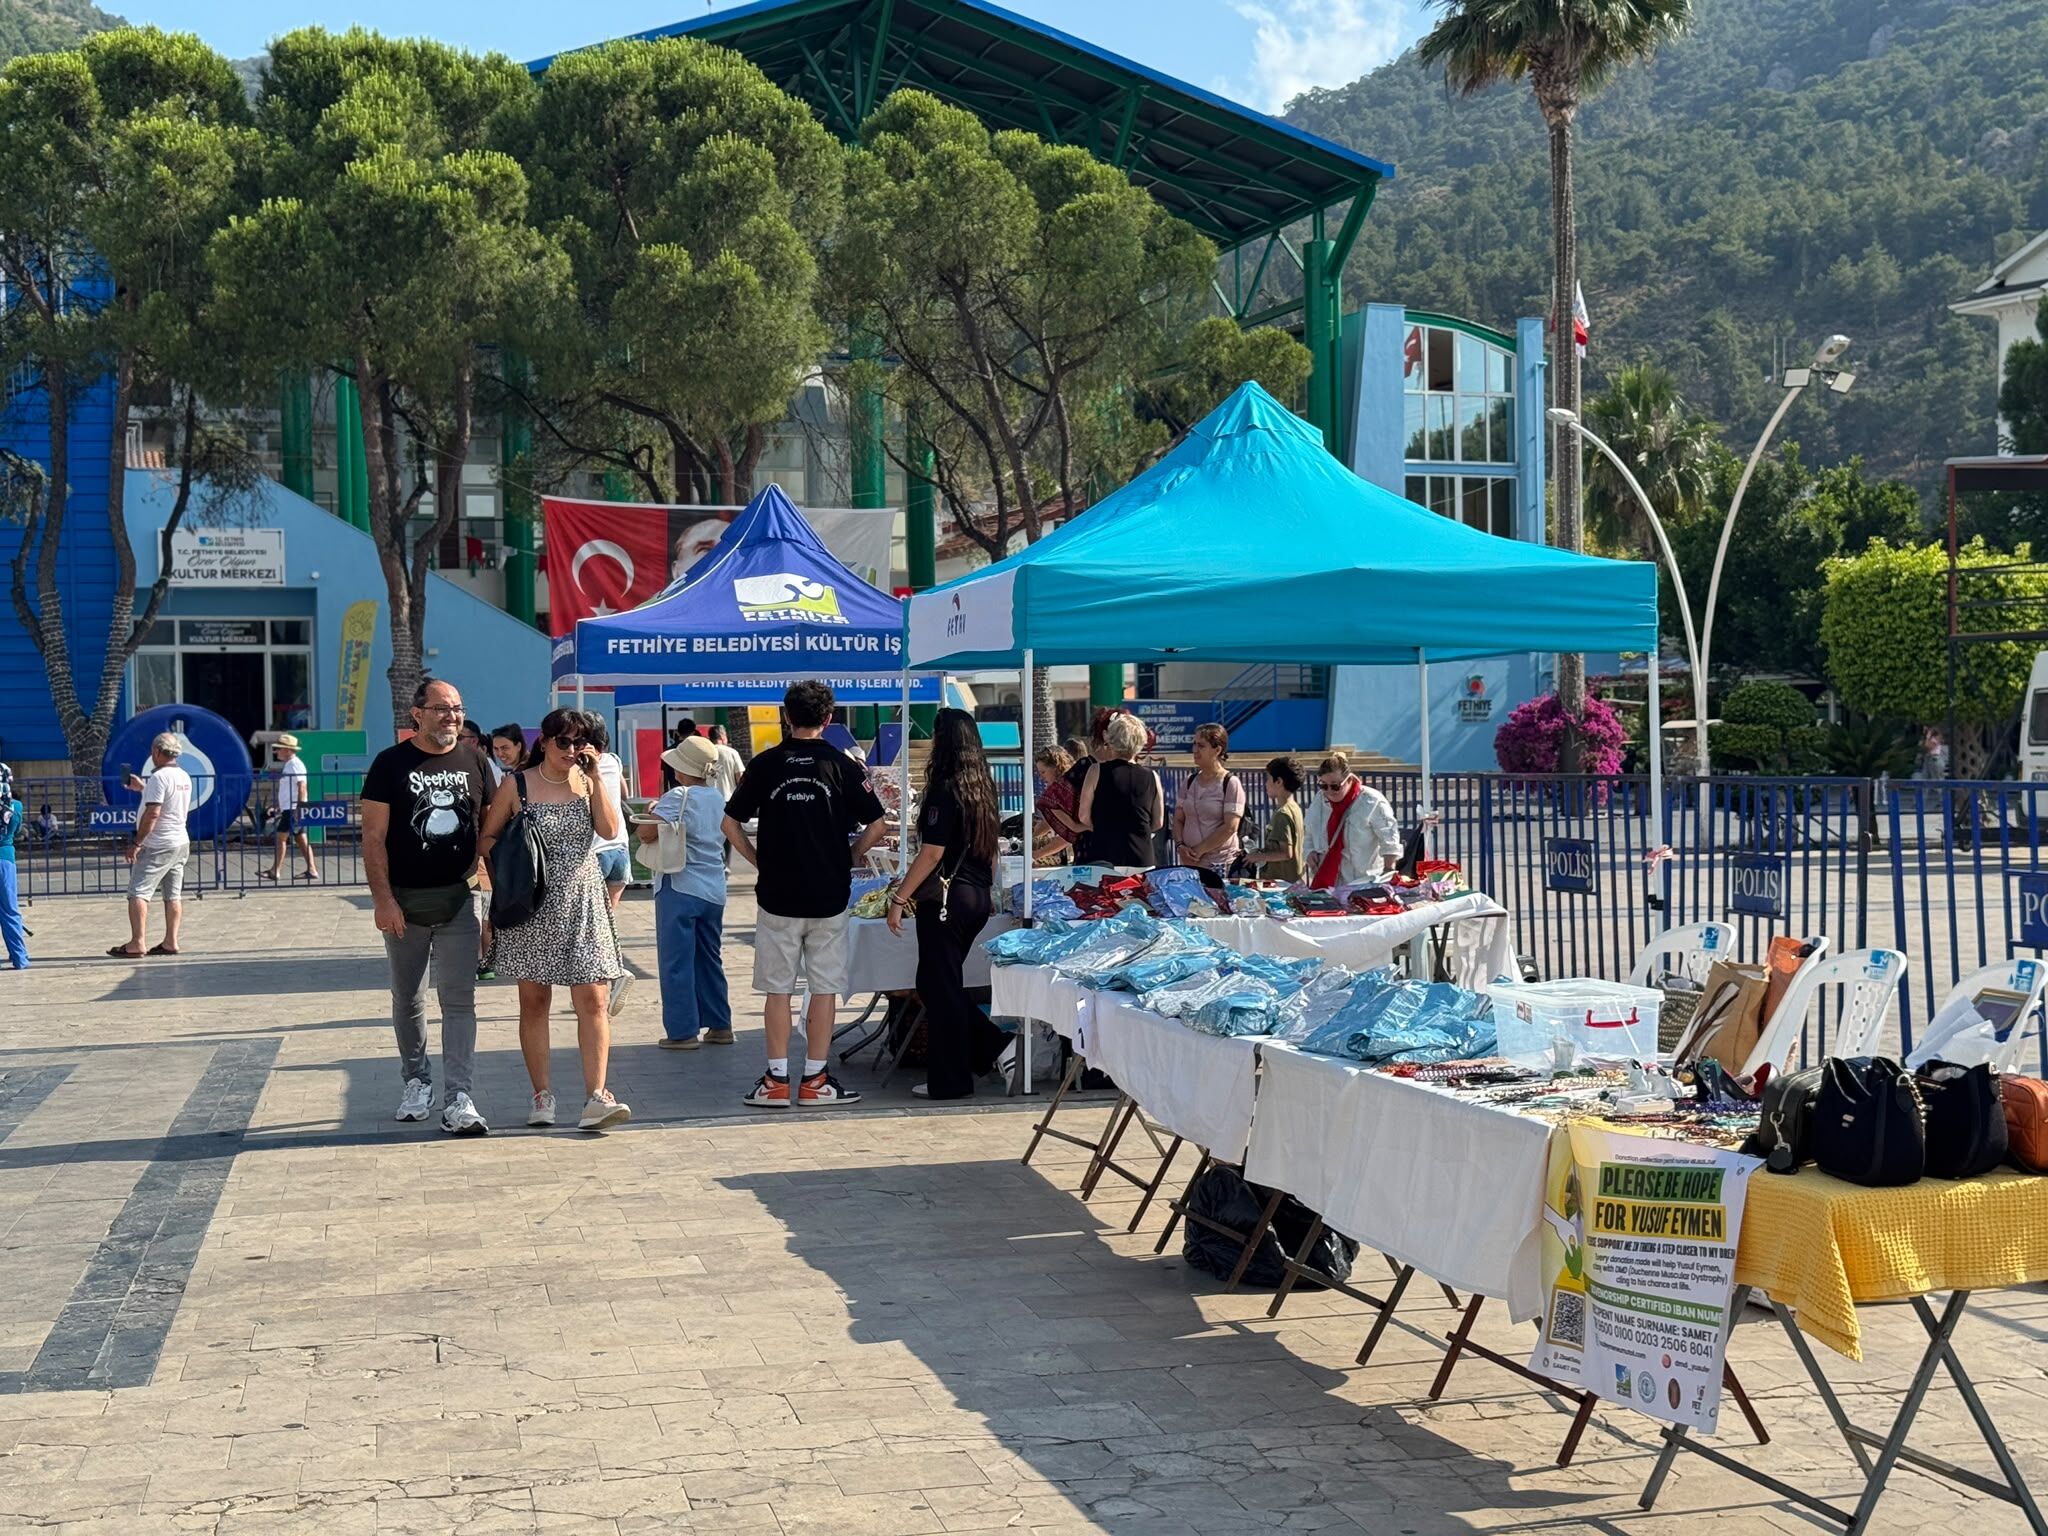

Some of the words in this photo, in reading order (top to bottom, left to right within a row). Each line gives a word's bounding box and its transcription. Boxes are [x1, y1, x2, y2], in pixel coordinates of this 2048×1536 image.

[607, 635, 687, 654] FETHİYE
[692, 632, 800, 653] BELEDİYESİ
[805, 632, 879, 652] KÜLTÜR
[884, 632, 902, 655] İŞ
[90, 810, 137, 825] POLİS
[301, 805, 345, 820] POLİS
[1550, 850, 1590, 879] POLİS
[1733, 866, 1778, 900] POLİS
[1602, 1166, 1664, 1198] PLEASE
[1663, 1170, 1681, 1199] BE
[1681, 1171, 1720, 1200] HOPE
[1595, 1201, 1627, 1232] FOR
[1631, 1204, 1672, 1234] YUSUF
[1670, 1206, 1722, 1238] EYMEN
[1676, 1244, 1698, 1257] CLOSER
[1698, 1246, 1707, 1257] TO
[1690, 1272, 1728, 1286] Dystrophy)
[1630, 1295, 1672, 1314] CERTIFIED
[1672, 1303, 1696, 1319] IBAN
[1614, 1311, 1636, 1327] NAME
[1636, 1317, 1680, 1336] SURNAME:
[1681, 1326, 1713, 1343] SAMET
[1634, 1330, 1659, 1348] 0203
[1660, 1336, 1687, 1353] 2506
